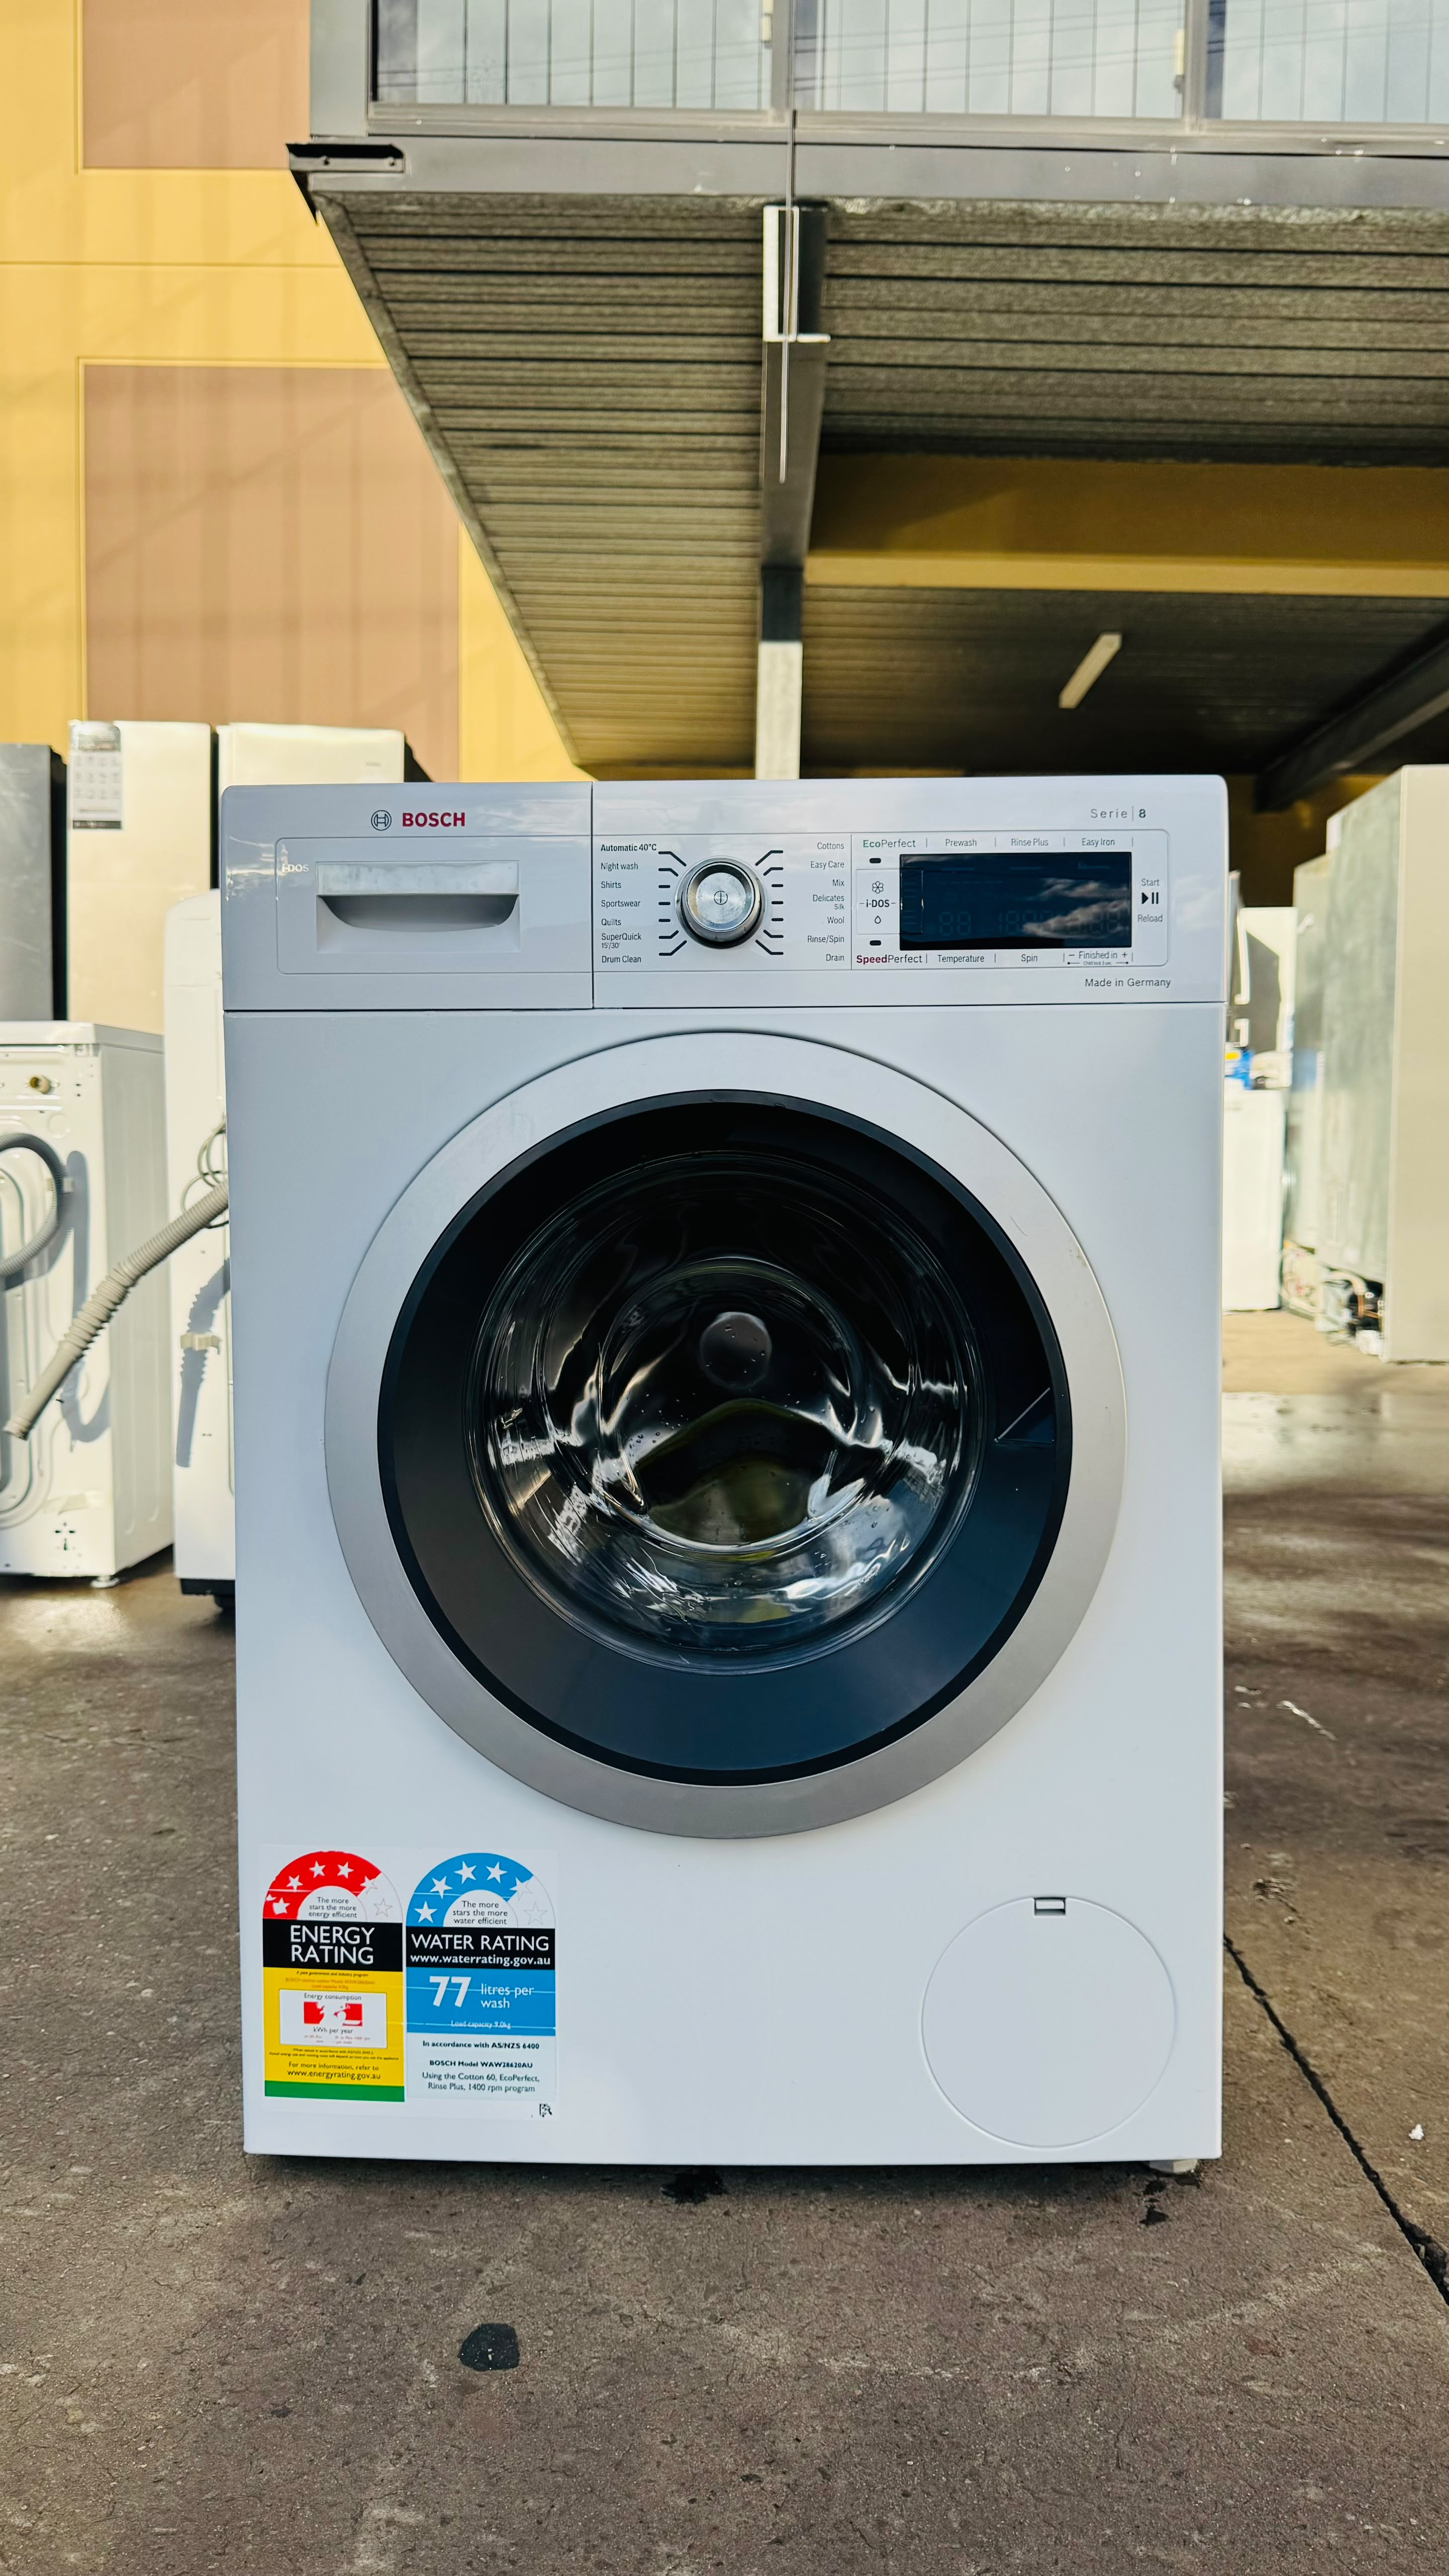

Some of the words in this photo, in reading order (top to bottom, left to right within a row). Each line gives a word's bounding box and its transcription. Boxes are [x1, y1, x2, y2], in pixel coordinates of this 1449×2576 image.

[1091, 809, 1128, 818] Serie
[1139, 809, 1147, 818] 8
[402, 812, 465, 827] BOSCH
[863, 839, 916, 848] EcoPerfect
[945, 839, 977, 847] Prewash
[1011, 838, 1031, 846] Rinse
[1033, 838, 1049, 846] Plus
[1082, 838, 1098, 847] Easy
[1101, 838, 1115, 846] Iron
[601, 862, 619, 871] Night
[811, 861, 827, 869] Easy
[1142, 878, 1159, 886] Start
[601, 900, 640, 909] Sportswear
[1138, 914, 1163, 922] Reload
[601, 933, 641, 941] SuperQuick
[808, 935, 844, 944] Rinse/Spin
[622, 955, 641, 963] Clean
[856, 954, 922, 964] SpeedPerfect
[938, 954, 985, 964] Temperature
[1021, 954, 1038, 963] Spin
[1079, 951, 1109, 959] Finished
[1111, 951, 1117, 959] in
[1085, 978, 1112, 987] Made
[1115, 978, 1123, 987] in
[1127, 978, 1171, 988] Germany
[290, 1924, 375, 1945] ENERGY
[411, 1934, 474, 1950] WATER
[480, 1935, 549, 1951] RATING
[291, 1944, 374, 1965] RATING
[410, 1954, 551, 1967] www.waterrating.gov.au
[429, 1976, 471, 2007] 77
[481, 1983, 510, 1995] litres
[514, 1987, 534, 1998] per
[304, 1992, 323, 2000] Energy
[480, 1997, 510, 2008] wash
[468, 2021, 493, 2029] capacity
[318, 2062, 354, 2070] information,
[287, 2069, 381, 2080] www.energyrating.gov.au
[422, 2071, 442, 2080] Using
[486, 2073, 497, 2081] 60,
[500, 2073, 540, 2082] EcoPerfect,
[449, 2082, 465, 2090] Plus,
[505, 2085, 535, 2094] program
